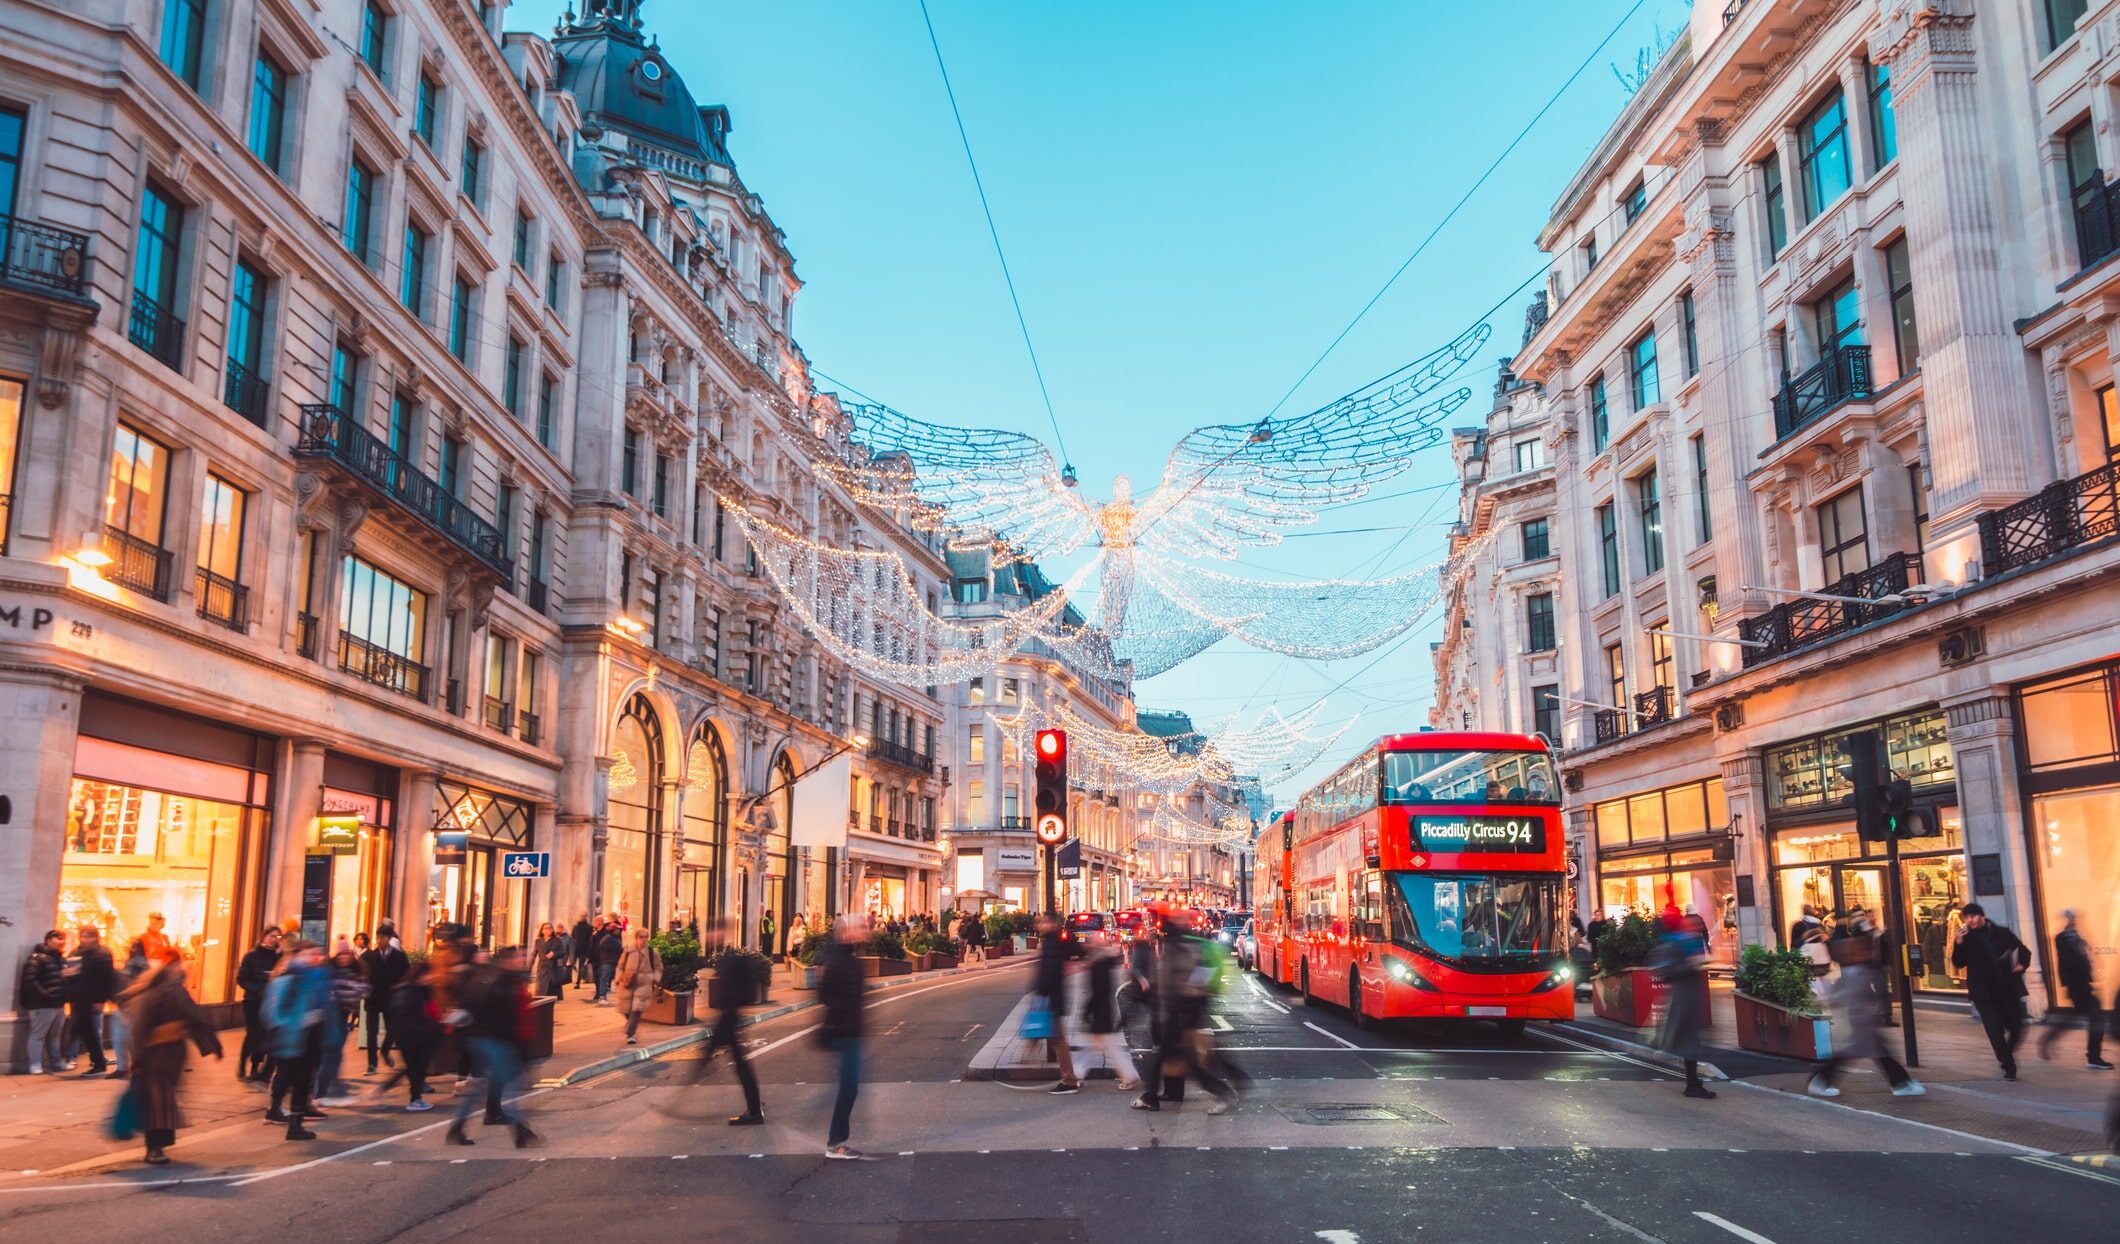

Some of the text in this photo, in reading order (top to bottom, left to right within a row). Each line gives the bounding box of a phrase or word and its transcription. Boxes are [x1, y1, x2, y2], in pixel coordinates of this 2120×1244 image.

[1421, 821, 1532, 843] Piccadilly Circus 94
